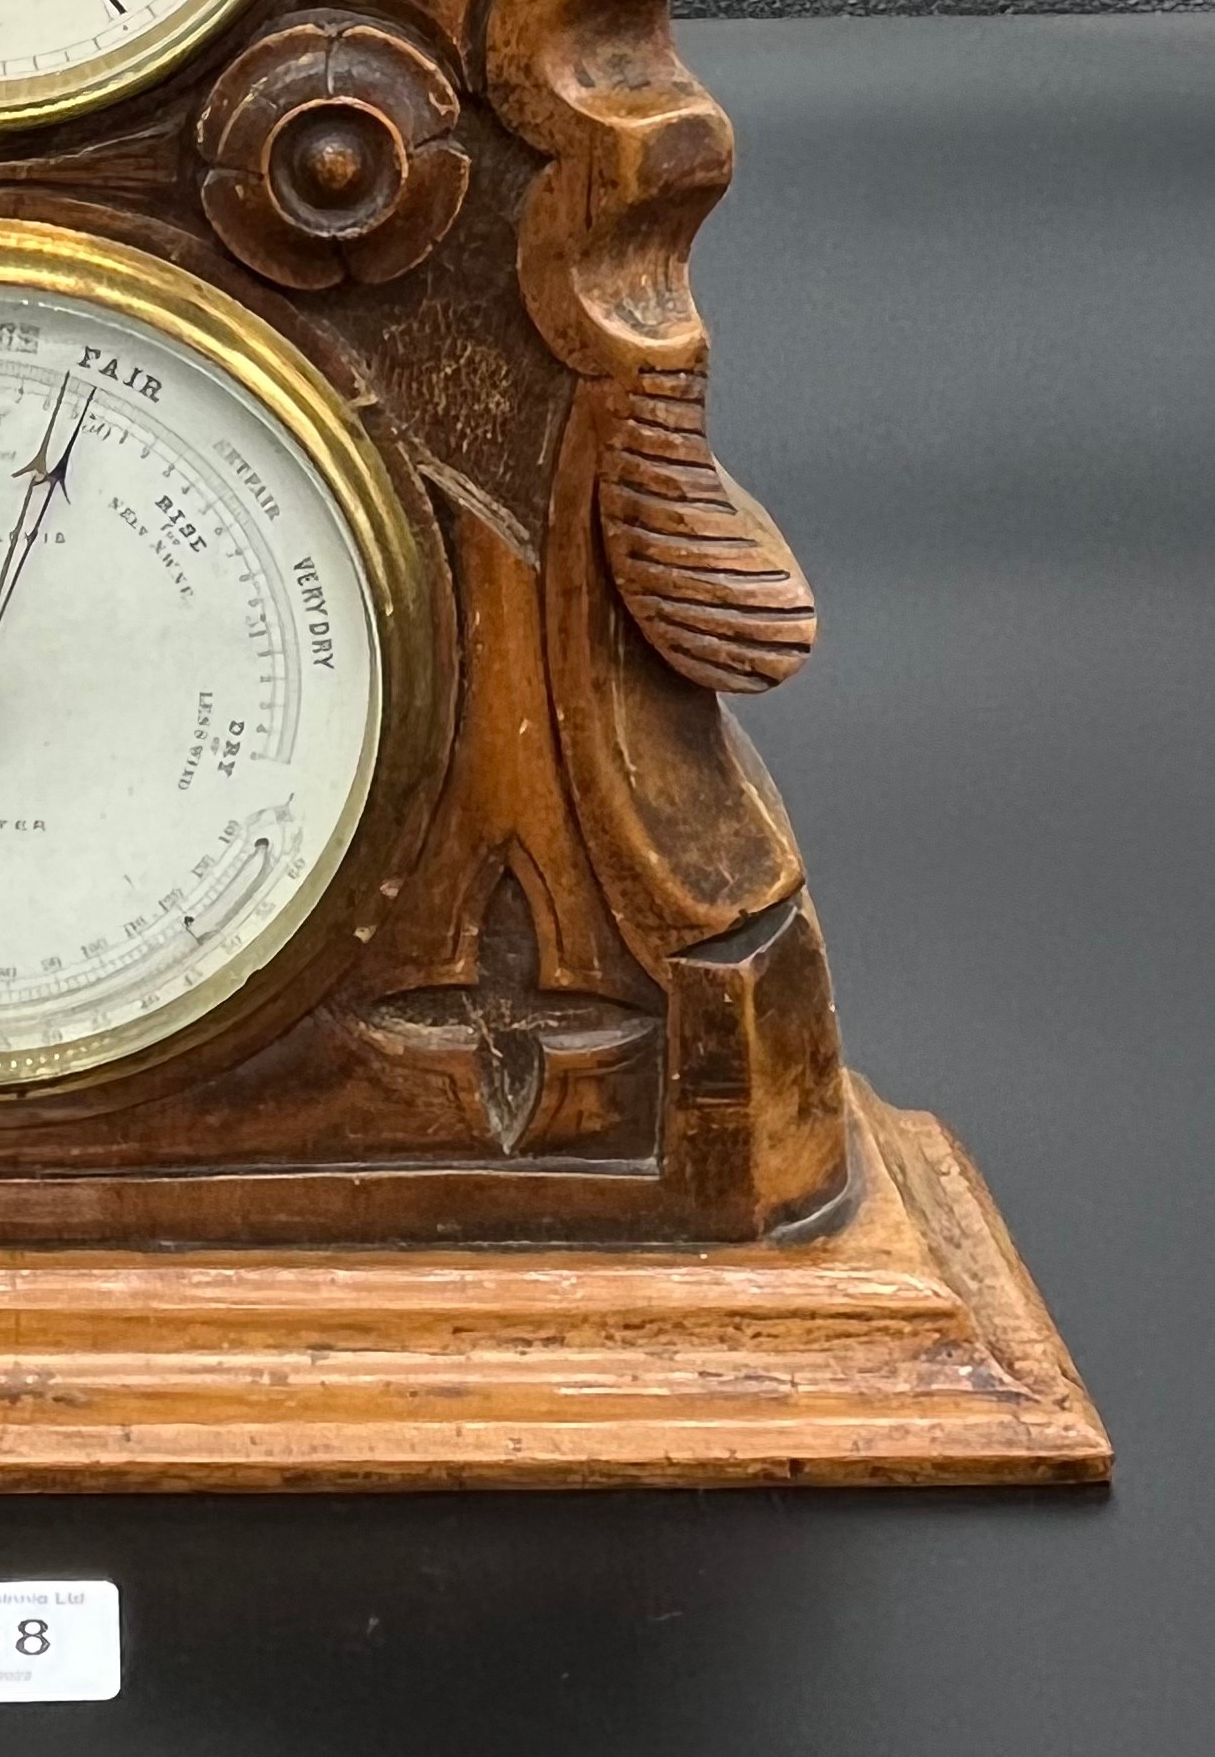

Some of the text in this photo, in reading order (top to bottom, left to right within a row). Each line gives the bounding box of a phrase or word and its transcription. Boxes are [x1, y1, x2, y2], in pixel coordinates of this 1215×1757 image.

[76, 346, 165, 404] FAIR
[293, 555, 336, 670] VERY DRY
